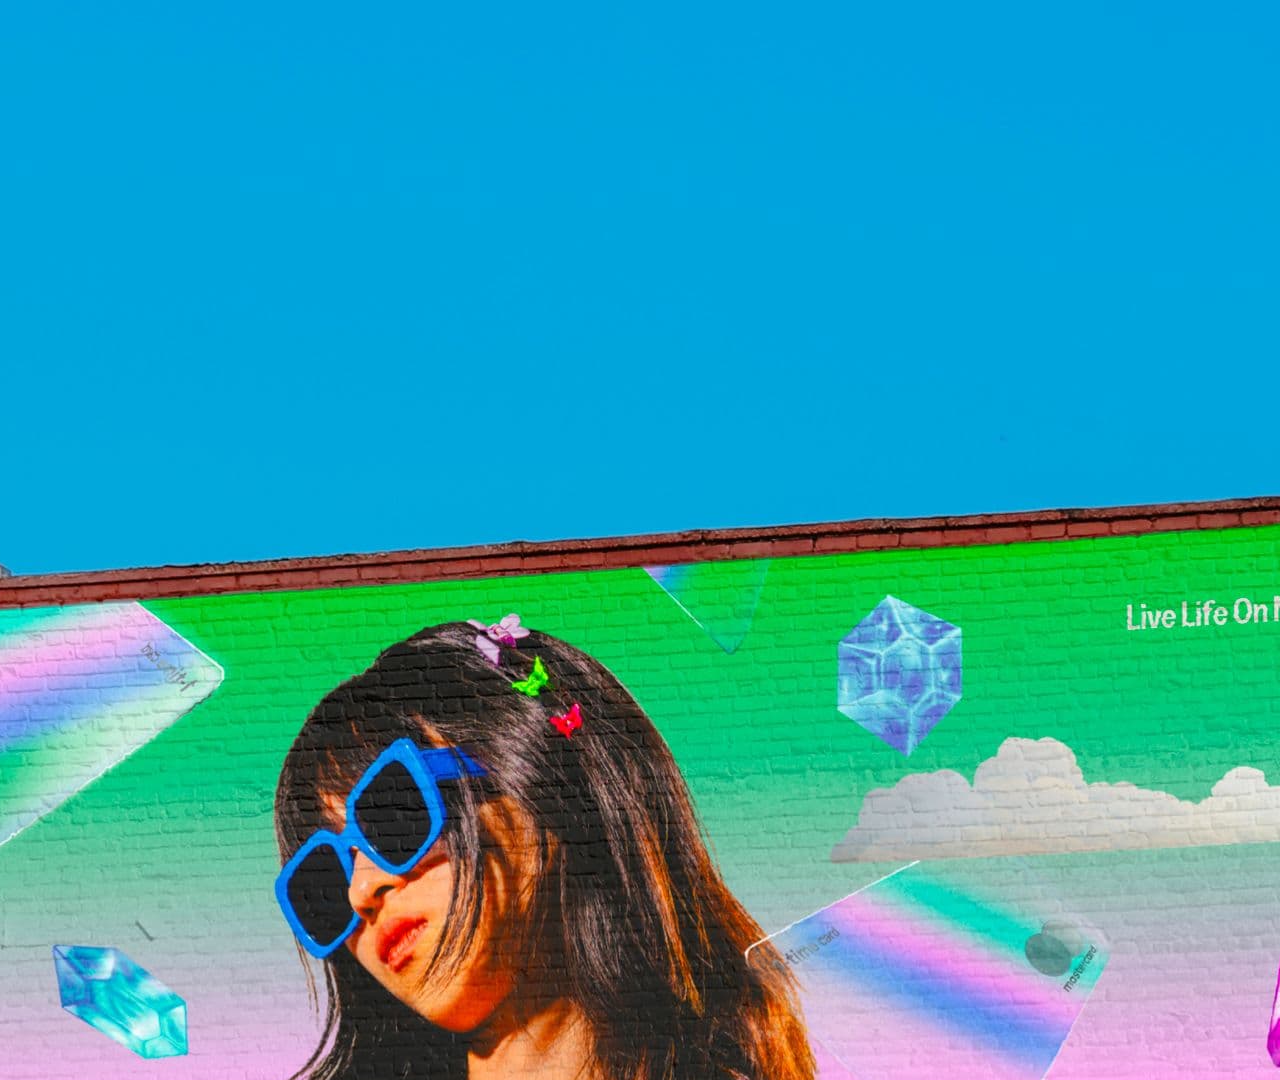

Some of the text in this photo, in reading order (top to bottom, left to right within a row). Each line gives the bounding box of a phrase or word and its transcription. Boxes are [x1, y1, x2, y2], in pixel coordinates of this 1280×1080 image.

[1126, 604, 1177, 631] Live
[1181, 599, 1229, 628] Life
[1233, 598, 1269, 625] On
[1063, 944, 1097, 993] mastercard
